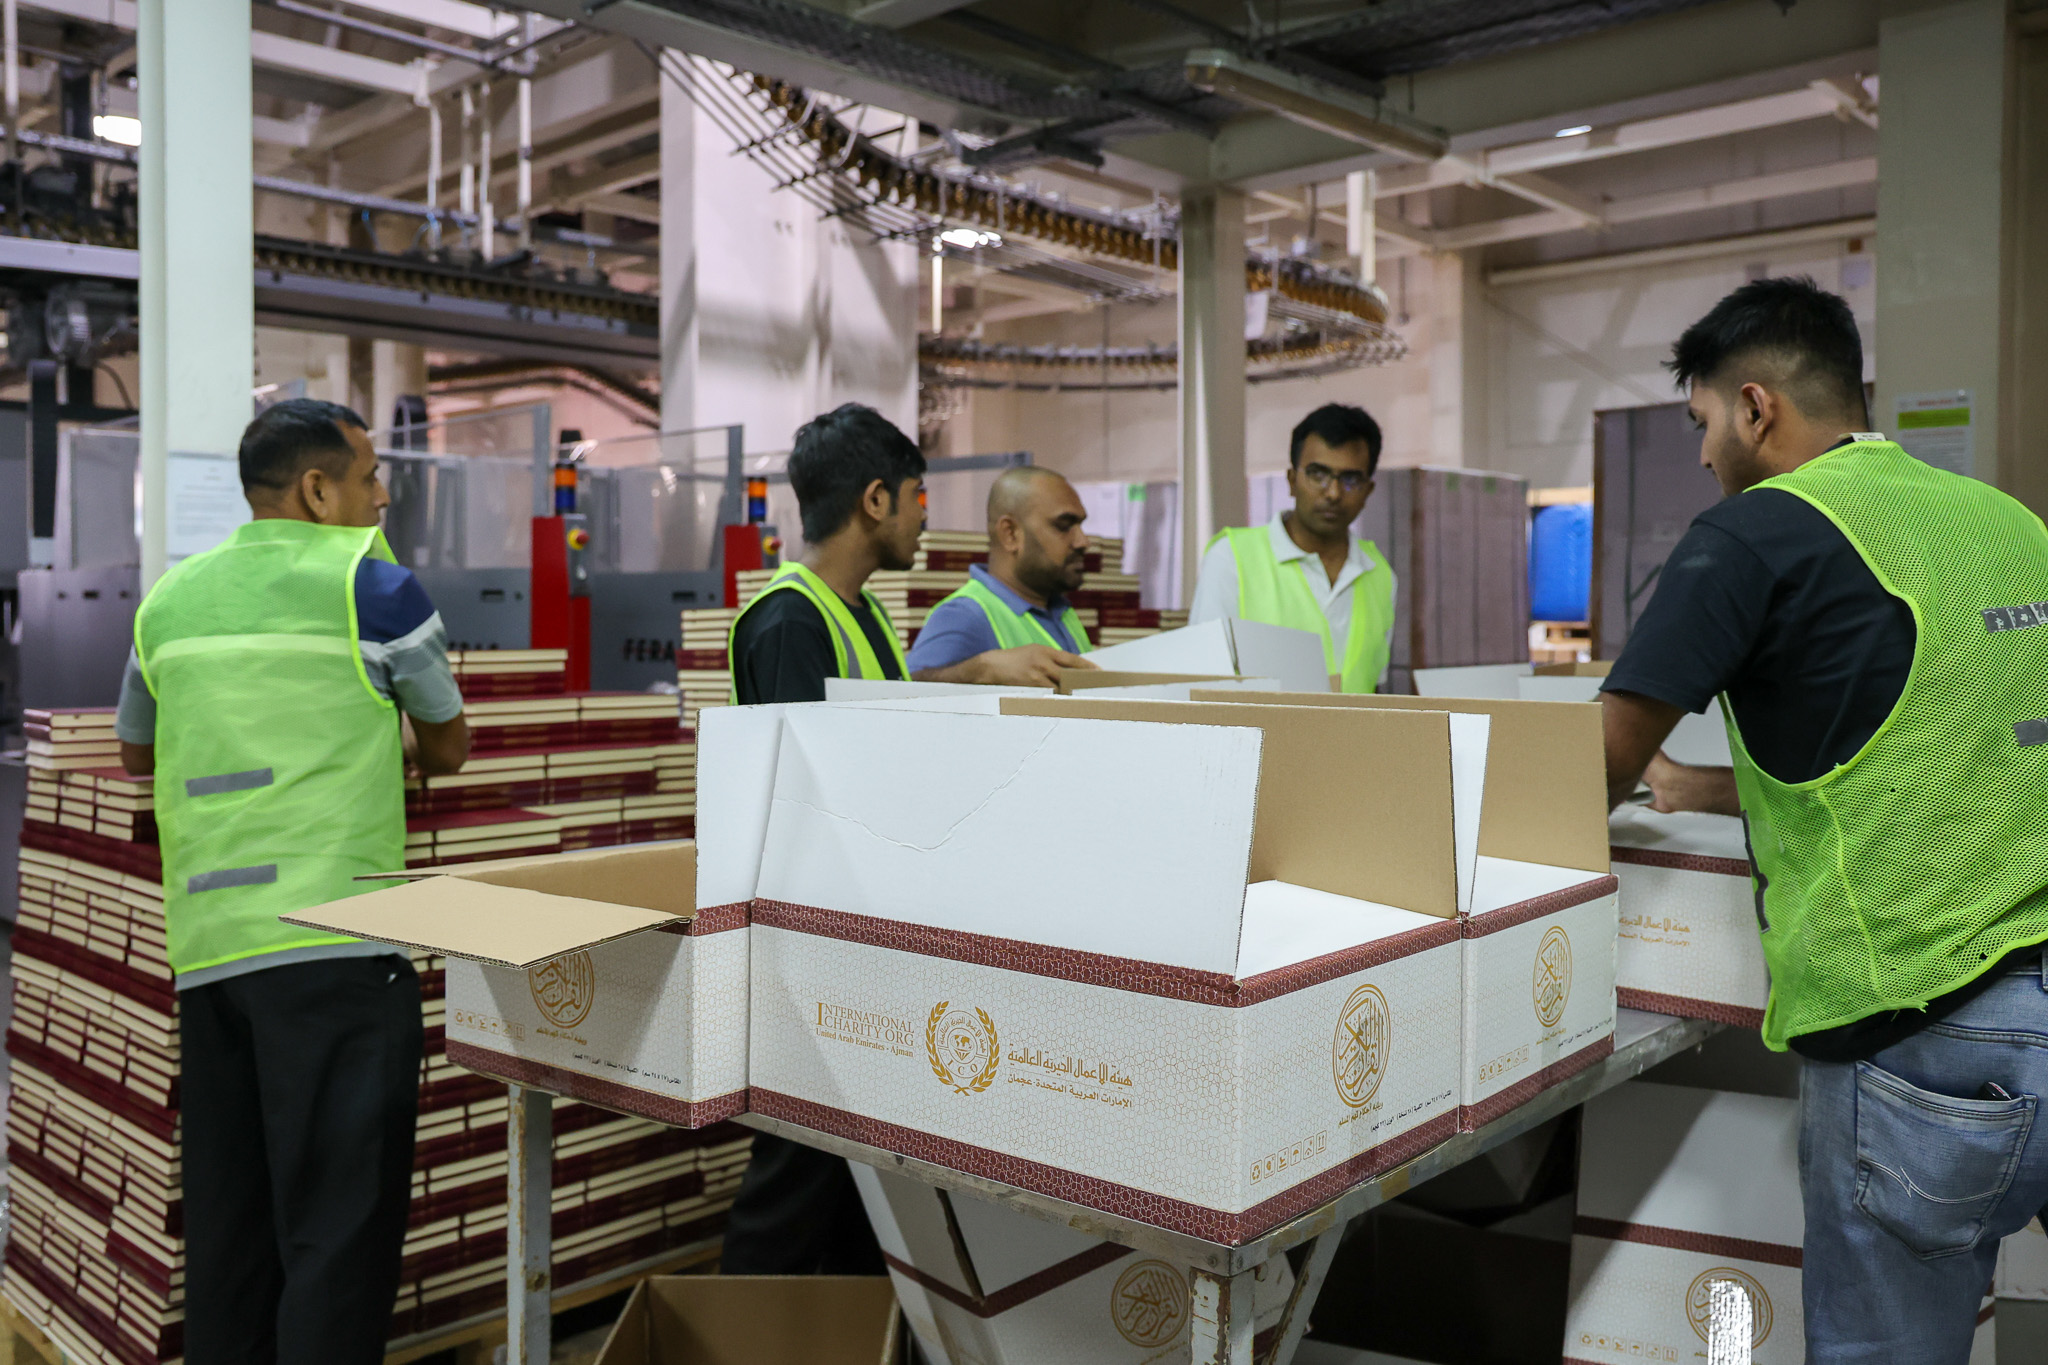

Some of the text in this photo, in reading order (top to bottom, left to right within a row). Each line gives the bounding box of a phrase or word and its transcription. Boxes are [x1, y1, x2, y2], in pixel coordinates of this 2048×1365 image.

[623, 638, 678, 662] FERA
[816, 1001, 915, 1034] INTERNATIONAL
[815, 1027, 837, 1040] United
[838, 1032, 855, 1044] Arab
[855, 1036, 885, 1051] Emirates
[890, 1045, 914, 1058] Ajman
[824, 1015, 914, 1047] CHARITY ORG
[1007, 1043, 1041, 1067] العالمية
[1043, 1050, 1072, 1076] الخيرية
[1007, 1073, 1033, 1086] عجمان
[1109, 1064, 1133, 1090] هيئة
[1069, 1084, 1099, 1100] العربية
